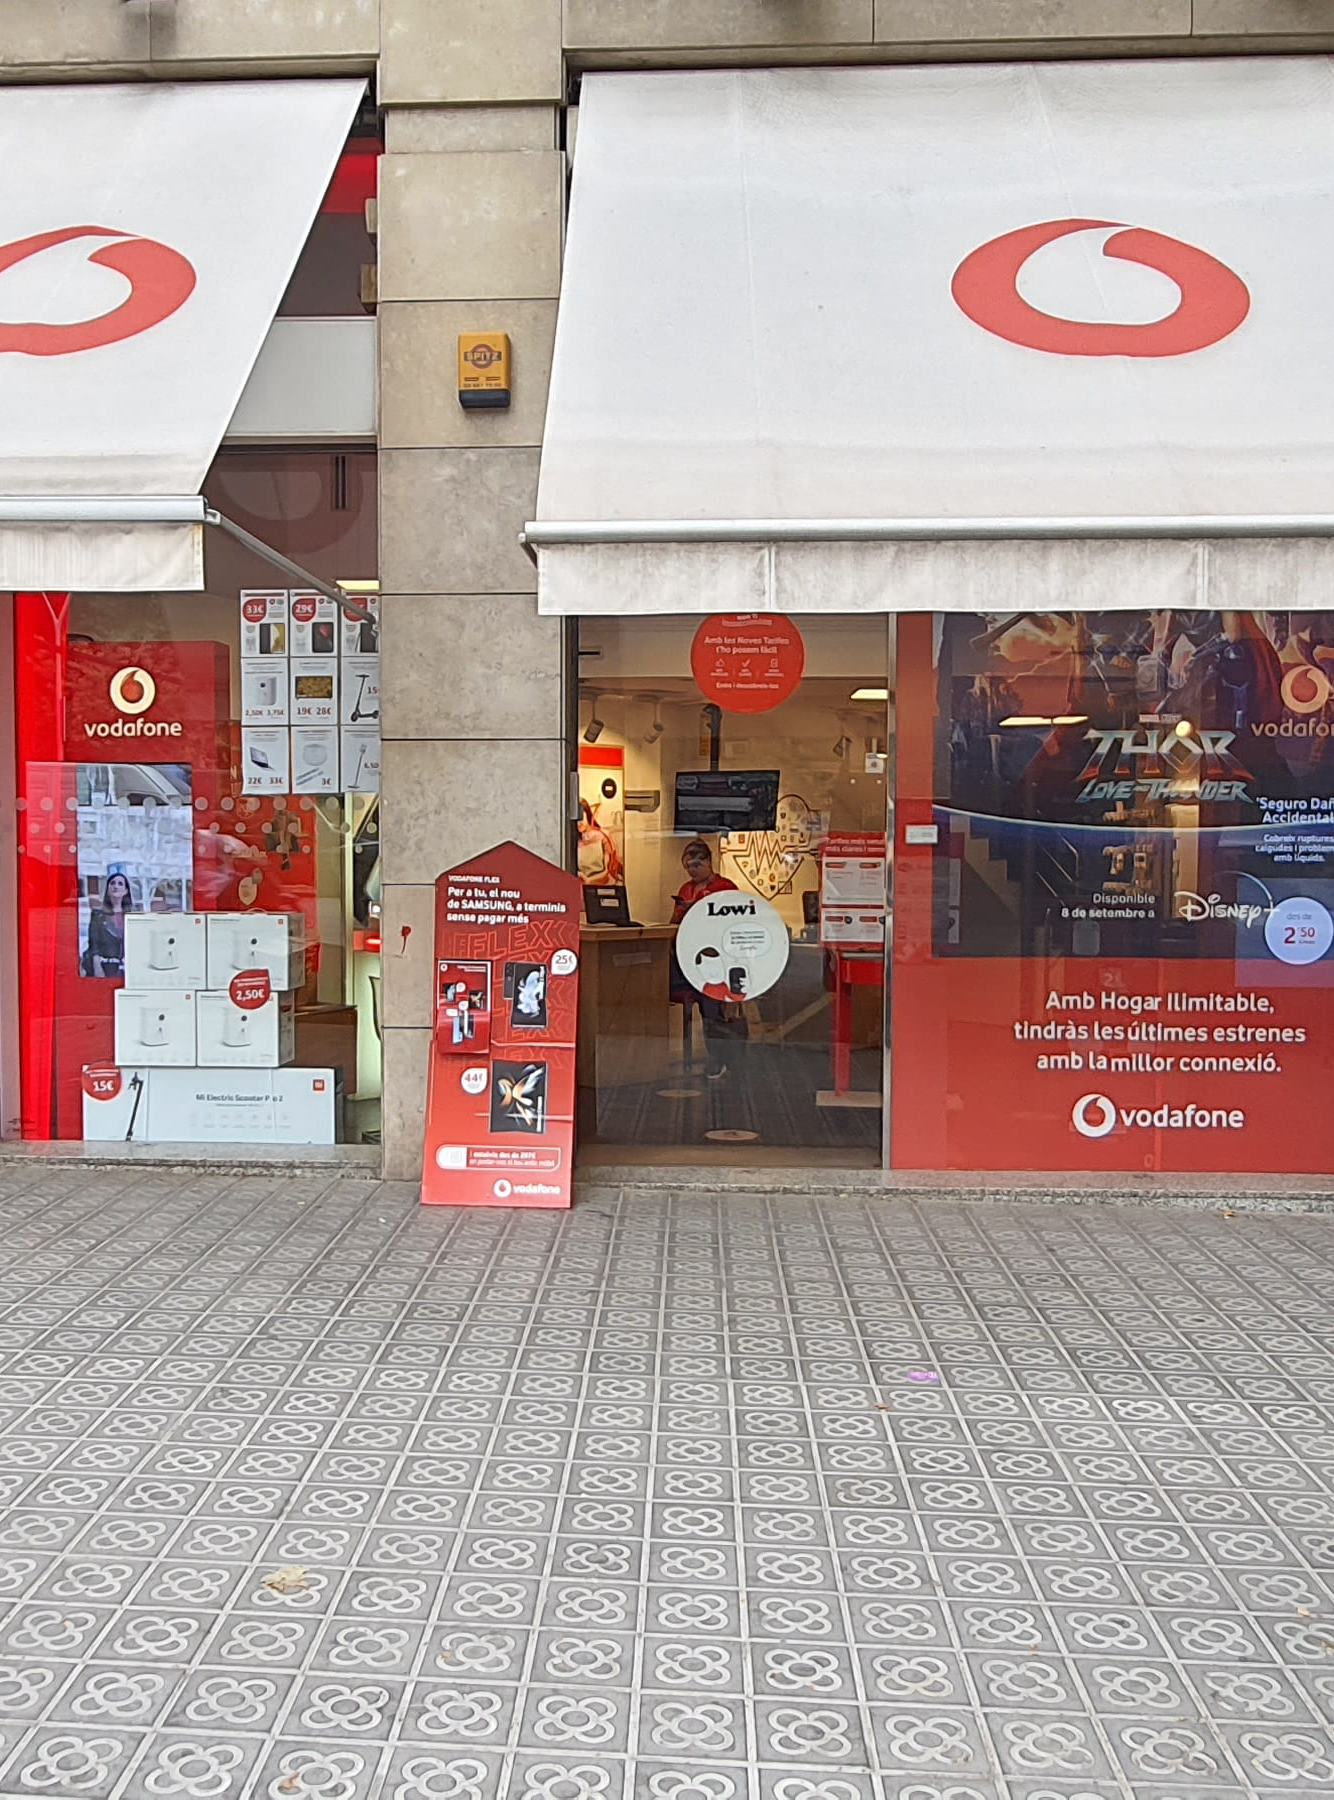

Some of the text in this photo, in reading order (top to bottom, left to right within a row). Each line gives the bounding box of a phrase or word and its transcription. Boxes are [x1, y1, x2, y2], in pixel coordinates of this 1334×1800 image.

[84, 718, 182, 737] vodafone
[448, 886, 464, 897] Per
[466, 889, 472, 897] a
[489, 888, 498, 898] el
[500, 890, 520, 899] nou
[1093, 892, 1155, 905] Disponible
[447, 899, 459, 909] de
[516, 904, 522, 912] a
[524, 902, 566, 913] terminis
[707, 900, 756, 917] Lowi
[1061, 907, 1155, 918] 8 de setembre a
[447, 913, 529, 925] sense pagar més
[555, 954, 573, 965] 25€
[236, 988, 265, 1001] 2,50€
[1045, 990, 1095, 1010] Amb
[1101, 991, 1162, 1014] Hogar
[1014, 1020, 1306, 1043] tindràs les últimes estrenes
[1037, 1051, 1282, 1072] amb la millor connexió.
[93, 1080, 114, 1092] 15€
[196, 1093, 205, 1101] Mi
[207, 1093, 234, 1102] Electric
[235, 1094, 264, 1102] Scooter
[265, 1094, 278, 1102] Po
[1120, 1103, 1245, 1128] vodafone
[514, 1183, 560, 1195] vodafone
